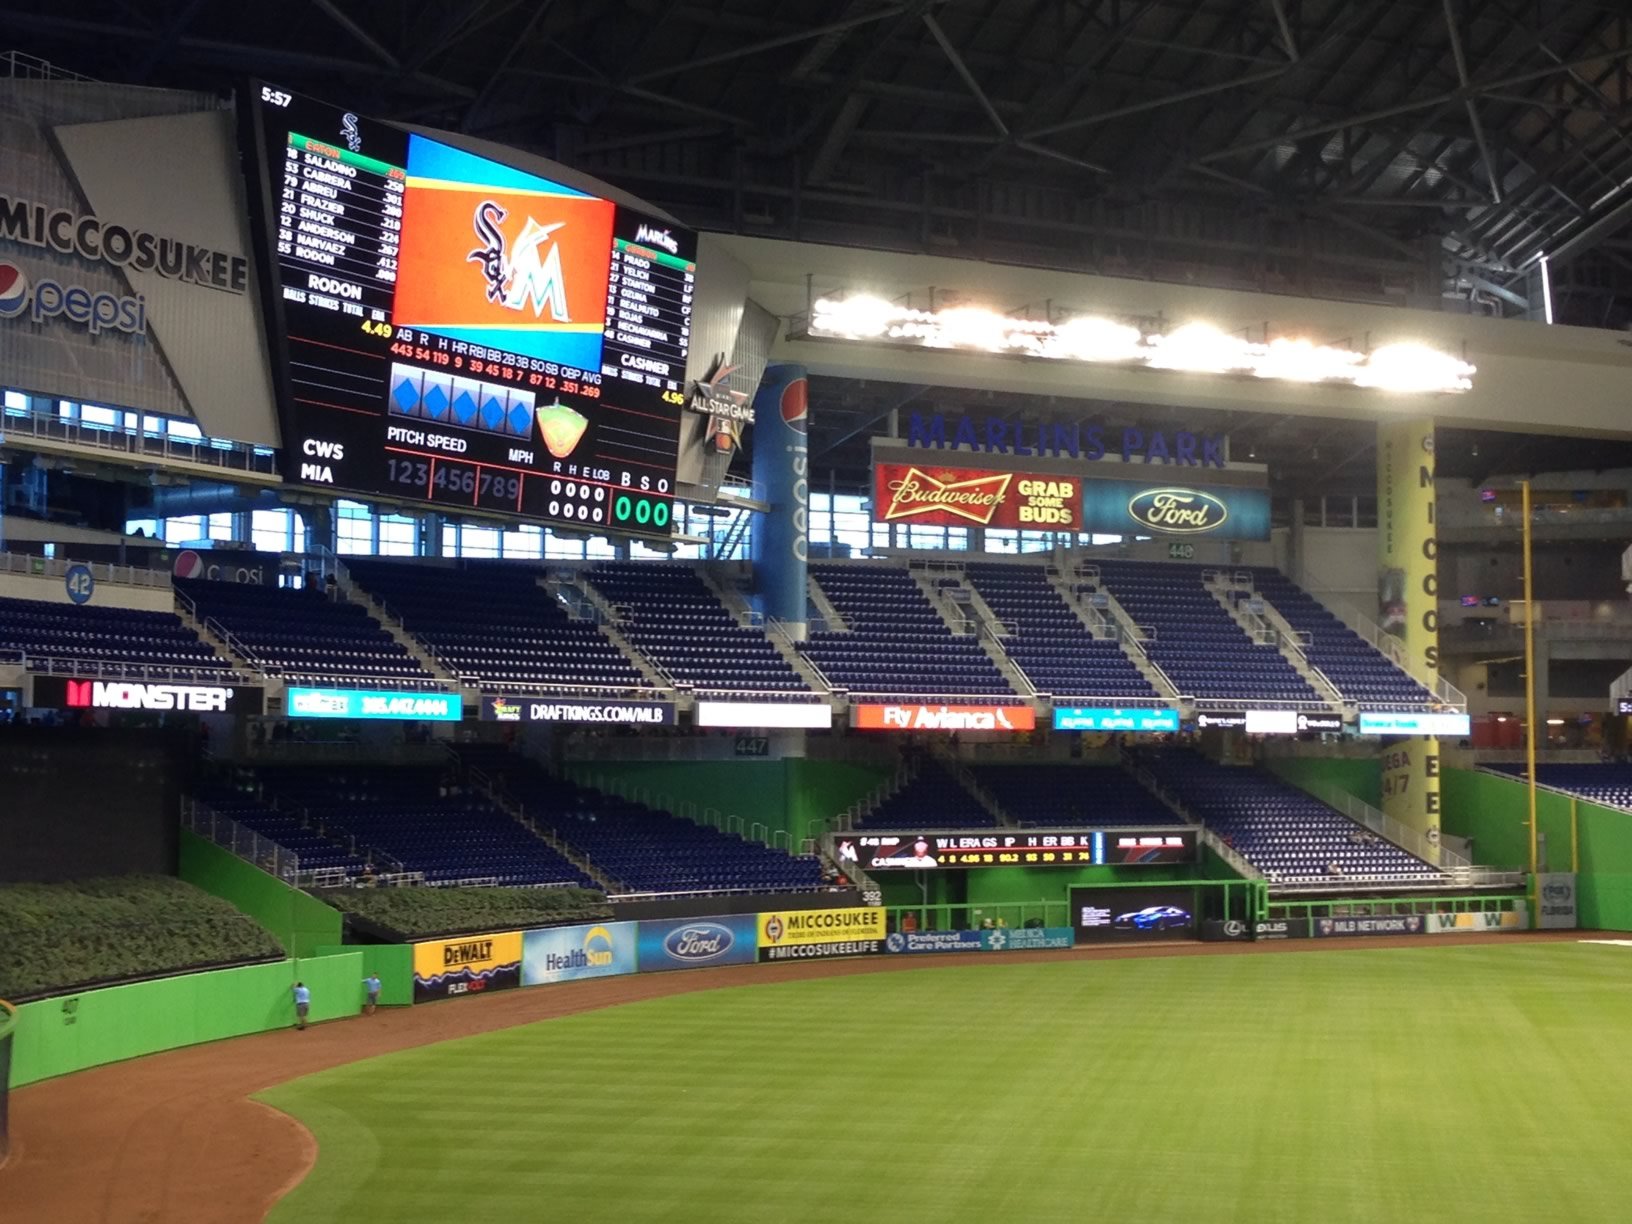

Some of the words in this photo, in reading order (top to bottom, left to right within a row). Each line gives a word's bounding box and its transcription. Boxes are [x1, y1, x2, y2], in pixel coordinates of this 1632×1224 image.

[262, 86, 292, 108] 5:57
[287, 148, 298, 160] 18
[304, 154, 356, 178] SALADINO
[284, 175, 298, 187] 79
[302, 181, 338, 198] ABREU
[286, 162, 298, 174] 53
[304, 168, 351, 190] CABRERA
[283, 189, 294, 200] 21
[300, 194, 344, 214] FRAZIER
[282, 202, 296, 214] 20
[300, 208, 334, 226] SHUCK
[280, 216, 292, 227] 12
[298, 221, 354, 244] ANDERSON
[0, 196, 247, 293] MICCOSUKEE
[279, 229, 292, 242] 38
[297, 234, 346, 256] NARVAEZ
[278, 242, 291, 254] 55
[296, 246, 334, 266] RODON
[624, 255, 650, 269] PRADO
[308, 274, 362, 300] RODON
[622, 277, 655, 293] STANTON
[32, 279, 146, 334] pepsi
[619, 310, 643, 324] ROJAS
[620, 299, 659, 317] REALMUTO
[361, 320, 392, 338] 4.49
[397, 329, 413, 342] AB
[420, 334, 429, 345] R
[439, 339, 448, 349] H
[452, 342, 468, 354] HR
[469, 345, 487, 358] RBI
[487, 349, 501, 362] BB
[502, 353, 516, 366] 2B
[516, 356, 528, 369] 3B
[530, 360, 545, 371] SO
[545, 363, 559, 375] SB
[561, 366, 581, 379] OBP
[582, 371, 601, 384] AVG
[681, 348, 687, 357] P
[391, 343, 413, 357] 443
[416, 348, 430, 361] 54
[432, 352, 449, 365] 119
[454, 357, 463, 368] 9
[469, 360, 483, 372] 39
[485, 364, 499, 376] 45
[502, 367, 513, 379] 18
[516, 371, 523, 381] 7
[530, 374, 543, 384] 87
[545, 377, 556, 388] 12
[560, 381, 579, 393] .351
[580, 385, 600, 398] .269
[621, 354, 669, 376] CASHNER
[662, 390, 684, 405] 4.96
[303, 439, 344, 460] CWS
[388, 426, 425, 445] PITCH
[427, 433, 467, 453] SPEED
[509, 449, 534, 464] MPH
[908, 411, 1105, 461] MARLINS
[1122, 428, 1226, 468] PARK
[301, 463, 334, 483] MIA
[553, 462, 561, 472] R
[569, 464, 576, 475] H
[583, 467, 590, 477] E
[592, 469, 610, 481] LOB
[621, 472, 631, 487] B
[641, 476, 650, 490] S
[888, 480, 1004, 506] Budweiser
[1018, 480, 1073, 498] GRAB
[1028, 497, 1063, 508] SOME
[1147, 493, 1208, 526] Ford
[1019, 506, 1072, 524] BUDS
[69, 573, 90, 594] 42
[93, 682, 226, 710] MONSTER
[531, 704, 663, 722] DRAFTKINGS.COM/MLB
[883, 707, 912, 727] Fly
[914, 706, 994, 729] Avianca
[737, 738, 766, 753] 447
[936, 838, 946, 848] W
[950, 839, 957, 848] L
[959, 838, 980, 848] ERA
[982, 838, 997, 847] GS
[1028, 837, 1037, 847] H
[1080, 836, 1088, 845] K
[862, 891, 882, 901] 392
[788, 912, 878, 929] MICCOSUKEE
[1334, 921, 1355, 932] MLB
[1358, 919, 1405, 932] NETWORK
[678, 929, 720, 954] Ford
[908, 933, 960, 942] Preferred
[908, 941, 932, 950] Care
[935, 940, 981, 949] Partners
[1009, 938, 1068, 948] HEALTHCARE
[546, 949, 612, 971] HealthSun
[769, 941, 878, 958] #MICCOSUKEELIFE
